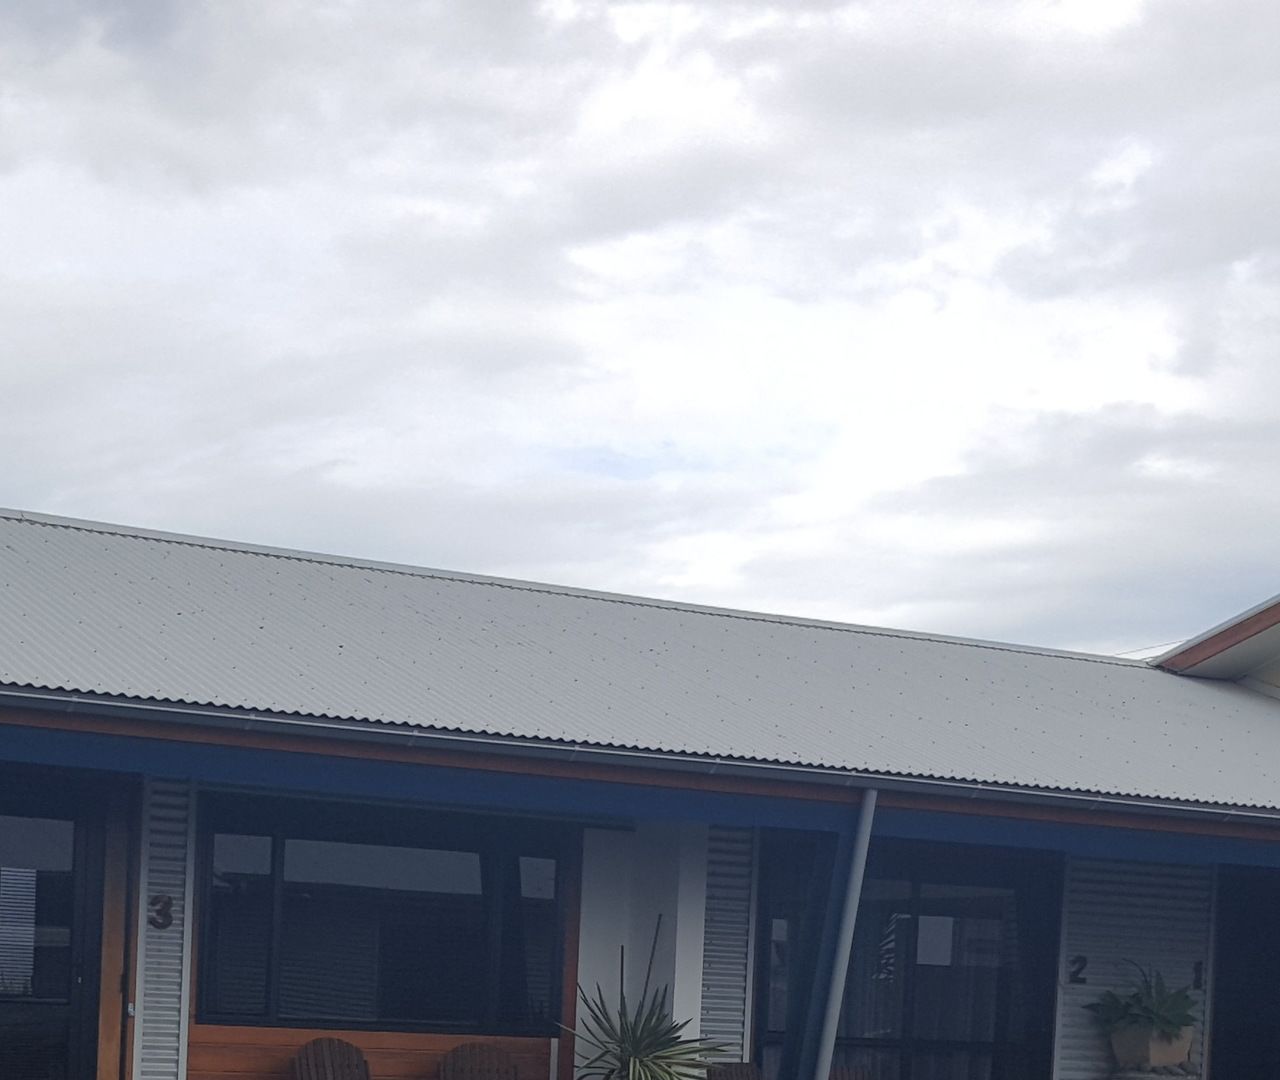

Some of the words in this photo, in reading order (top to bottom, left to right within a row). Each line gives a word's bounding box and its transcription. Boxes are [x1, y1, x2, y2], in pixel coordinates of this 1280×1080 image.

[150, 894, 172, 930] 3
[1069, 955, 1087, 984] 2
[1193, 960, 1203, 990] 1
